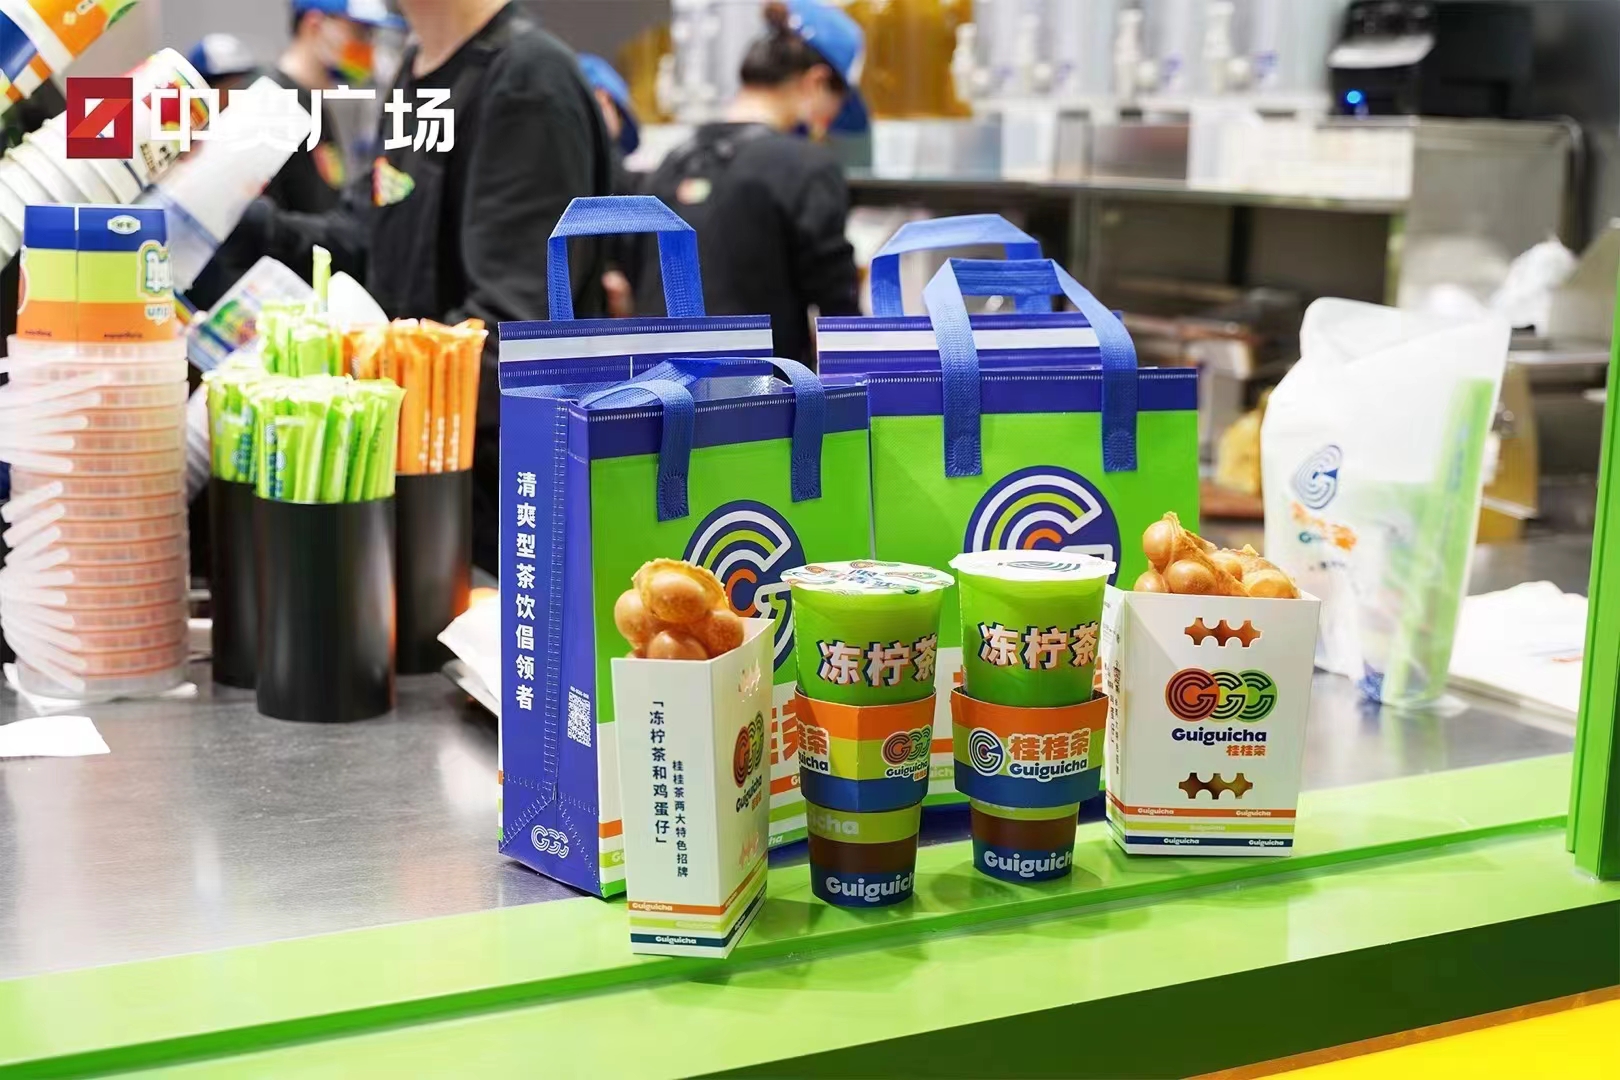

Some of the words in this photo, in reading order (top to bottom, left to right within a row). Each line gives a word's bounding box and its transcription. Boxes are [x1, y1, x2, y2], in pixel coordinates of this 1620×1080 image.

[514, 471, 538, 711] 清爽型茶饮倡领者
[977, 620, 1100, 669] 冻柠茶
[816, 633, 938, 688] 冻柠茶
[1009, 729, 1090, 761] 桂桂茶
[1171, 727, 1267, 746] Guiguicha
[798, 751, 829, 771] uicha
[886, 761, 928, 777] Guiguicha
[1009, 759, 1088, 779] Guiguicha
[672, 760, 689, 878] 桂桂茶两大特色招牌
[1137, 807, 1175, 817] Guiguicha
[1235, 809, 1272, 819] Guiguicha
[1163, 837, 1200, 846] Guiguicha
[1248, 839, 1284, 848] Guiguicha
[631, 902, 673, 911] Guiguicha
[655, 936, 697, 945] Guiguicha
